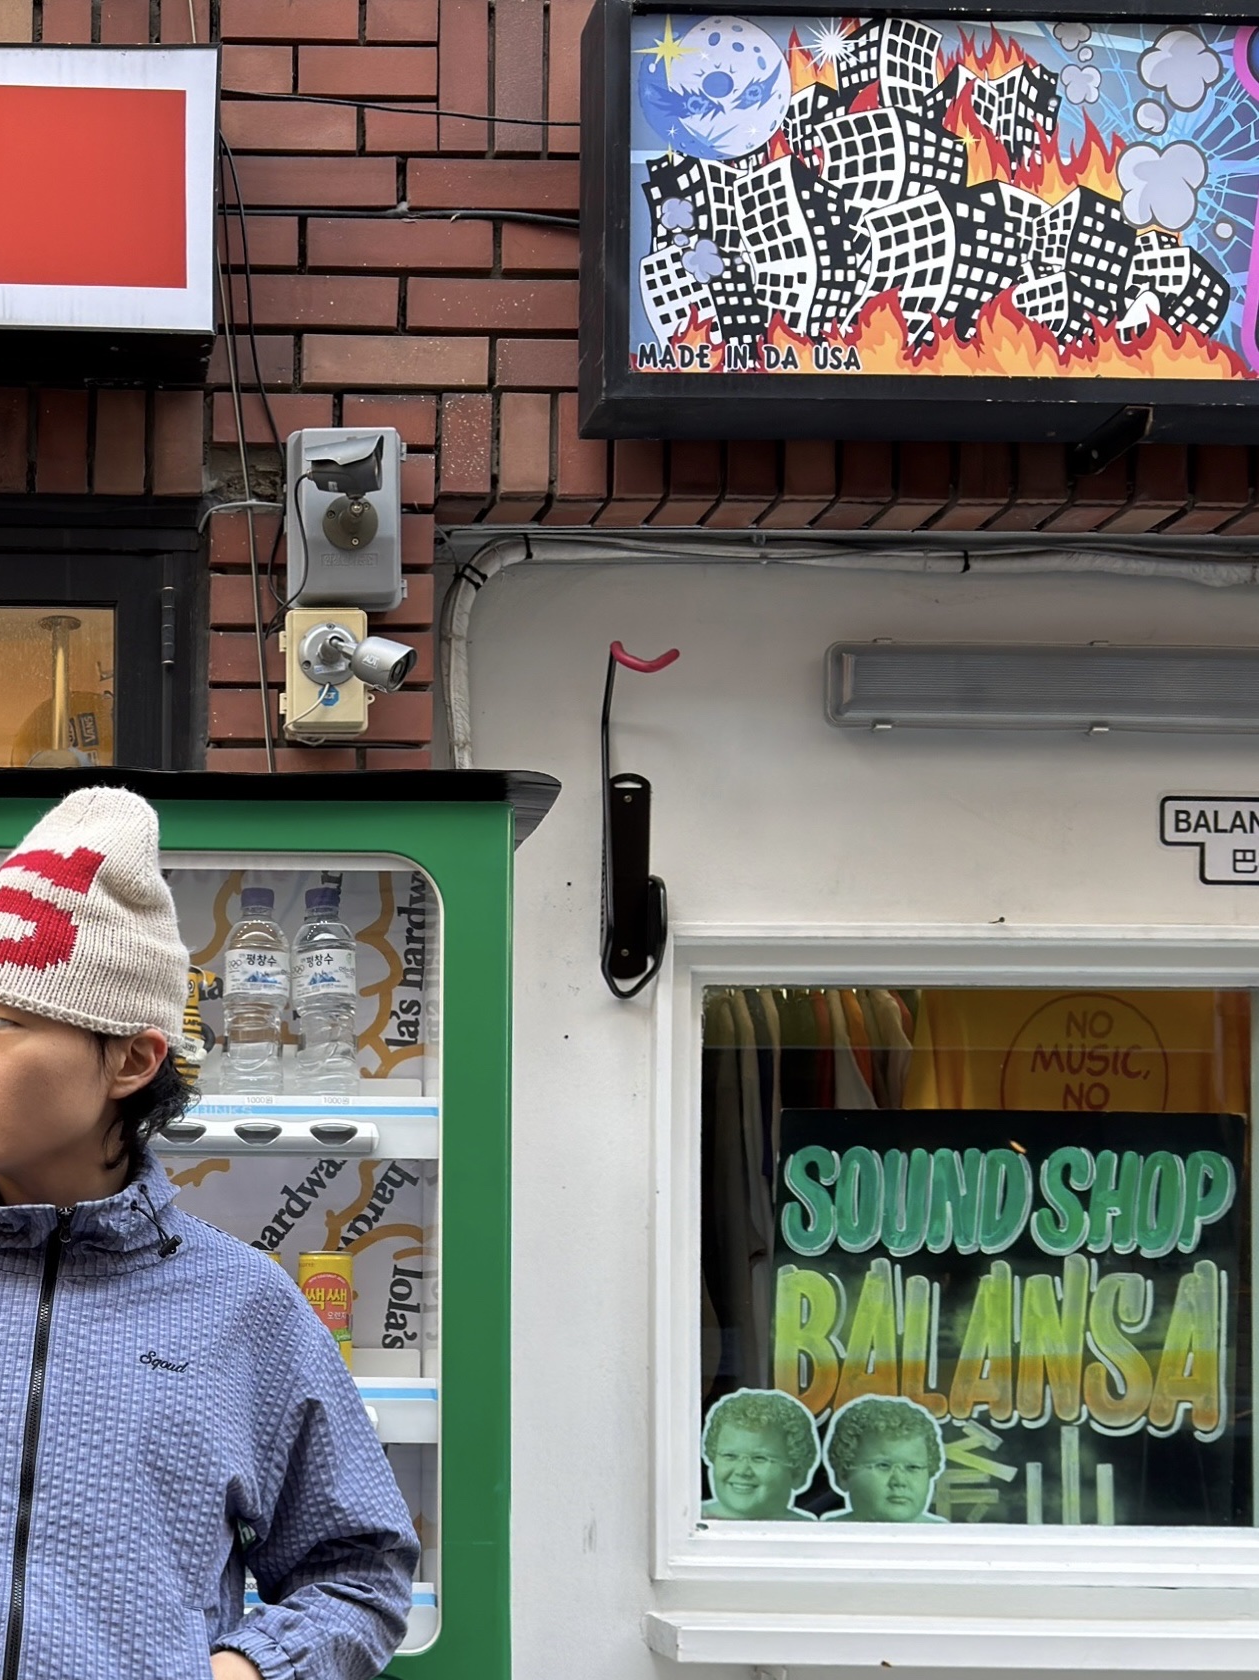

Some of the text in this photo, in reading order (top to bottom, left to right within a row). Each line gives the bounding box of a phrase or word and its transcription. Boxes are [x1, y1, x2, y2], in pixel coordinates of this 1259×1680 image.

[637, 343, 862, 371] MADE IN DA USA
[245, 953, 277, 968] 평창수
[306, 952, 334, 969] 평창수
[1065, 1009, 1115, 1039] NO
[1029, 1042, 1151, 1081] MUSIC,
[246, 1096, 273, 1104] 1000원
[323, 1096, 350, 1105] 1000원
[1062, 1082, 1111, 1110] NO
[781, 1144, 1237, 1259] SOUND SHOP
[773, 1253, 1228, 1443] BALANSA
